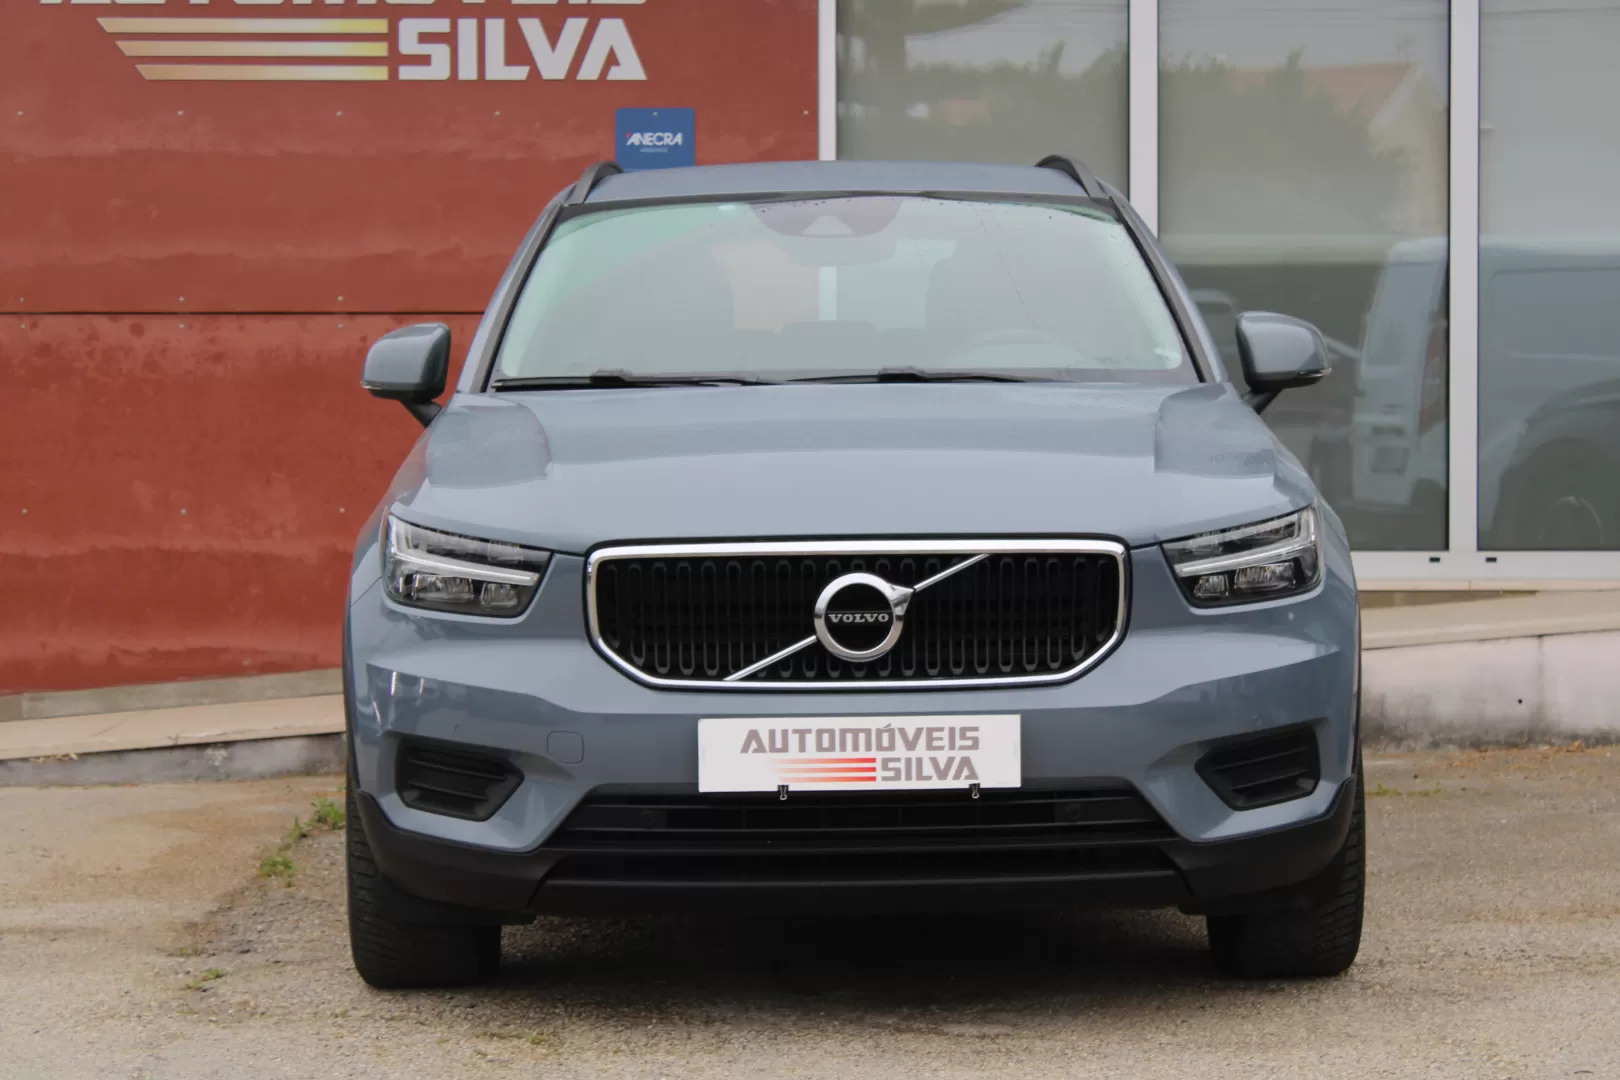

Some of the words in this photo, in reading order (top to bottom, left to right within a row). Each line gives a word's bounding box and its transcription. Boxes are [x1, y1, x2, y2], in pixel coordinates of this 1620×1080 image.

[398, 17, 648, 81] SILVA
[626, 132, 683, 146] ANECRA
[828, 613, 889, 623] VOLVO
[740, 723, 980, 754] AUTOMÓVEIS
[880, 756, 979, 782] SILVA
